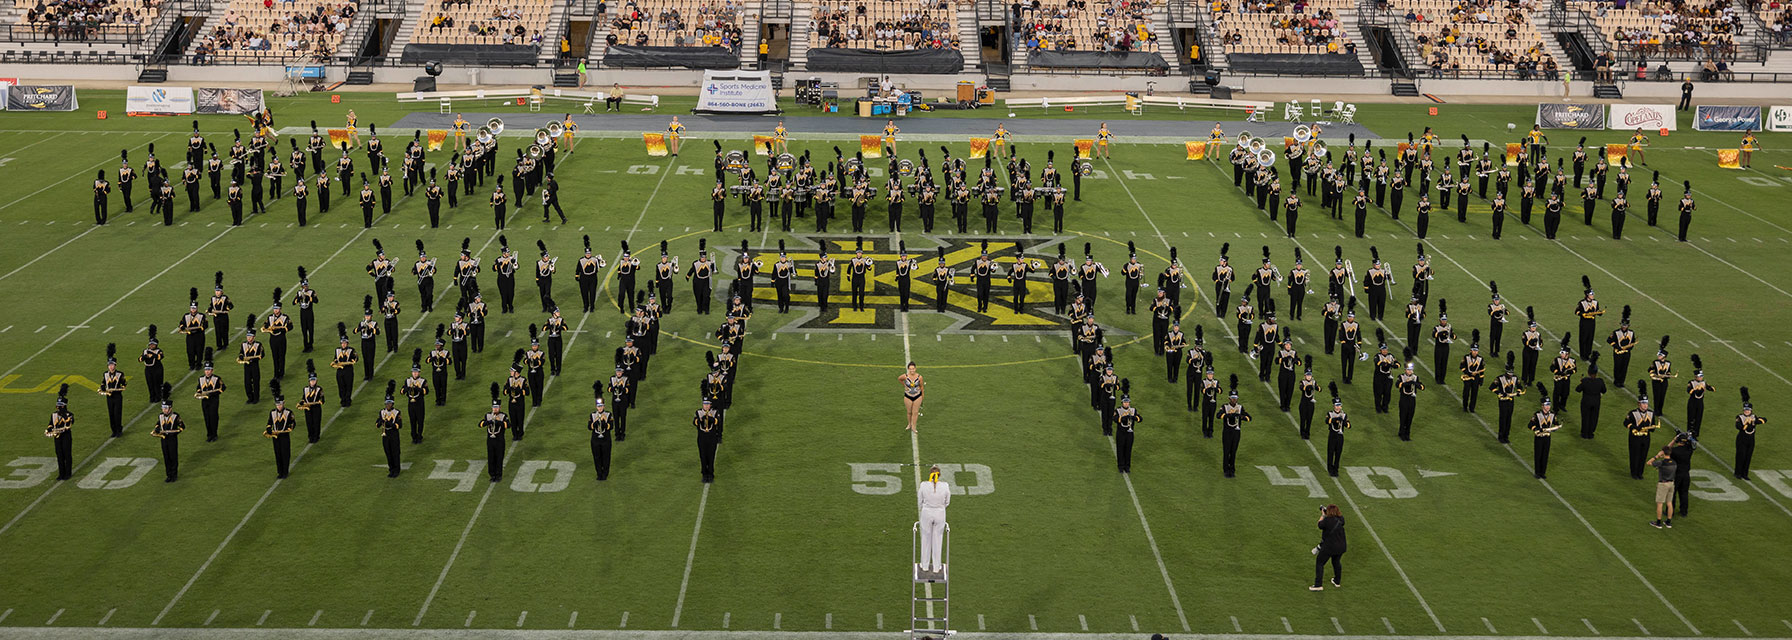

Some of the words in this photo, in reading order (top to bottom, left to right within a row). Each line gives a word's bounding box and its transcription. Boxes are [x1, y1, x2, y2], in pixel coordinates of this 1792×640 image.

[720, 83, 740, 91] Sports
[1713, 116, 1737, 124] Georgia
[427, 459, 577, 493] 40
[846, 462, 996, 496] 50
[1254, 465, 1420, 499] 40
